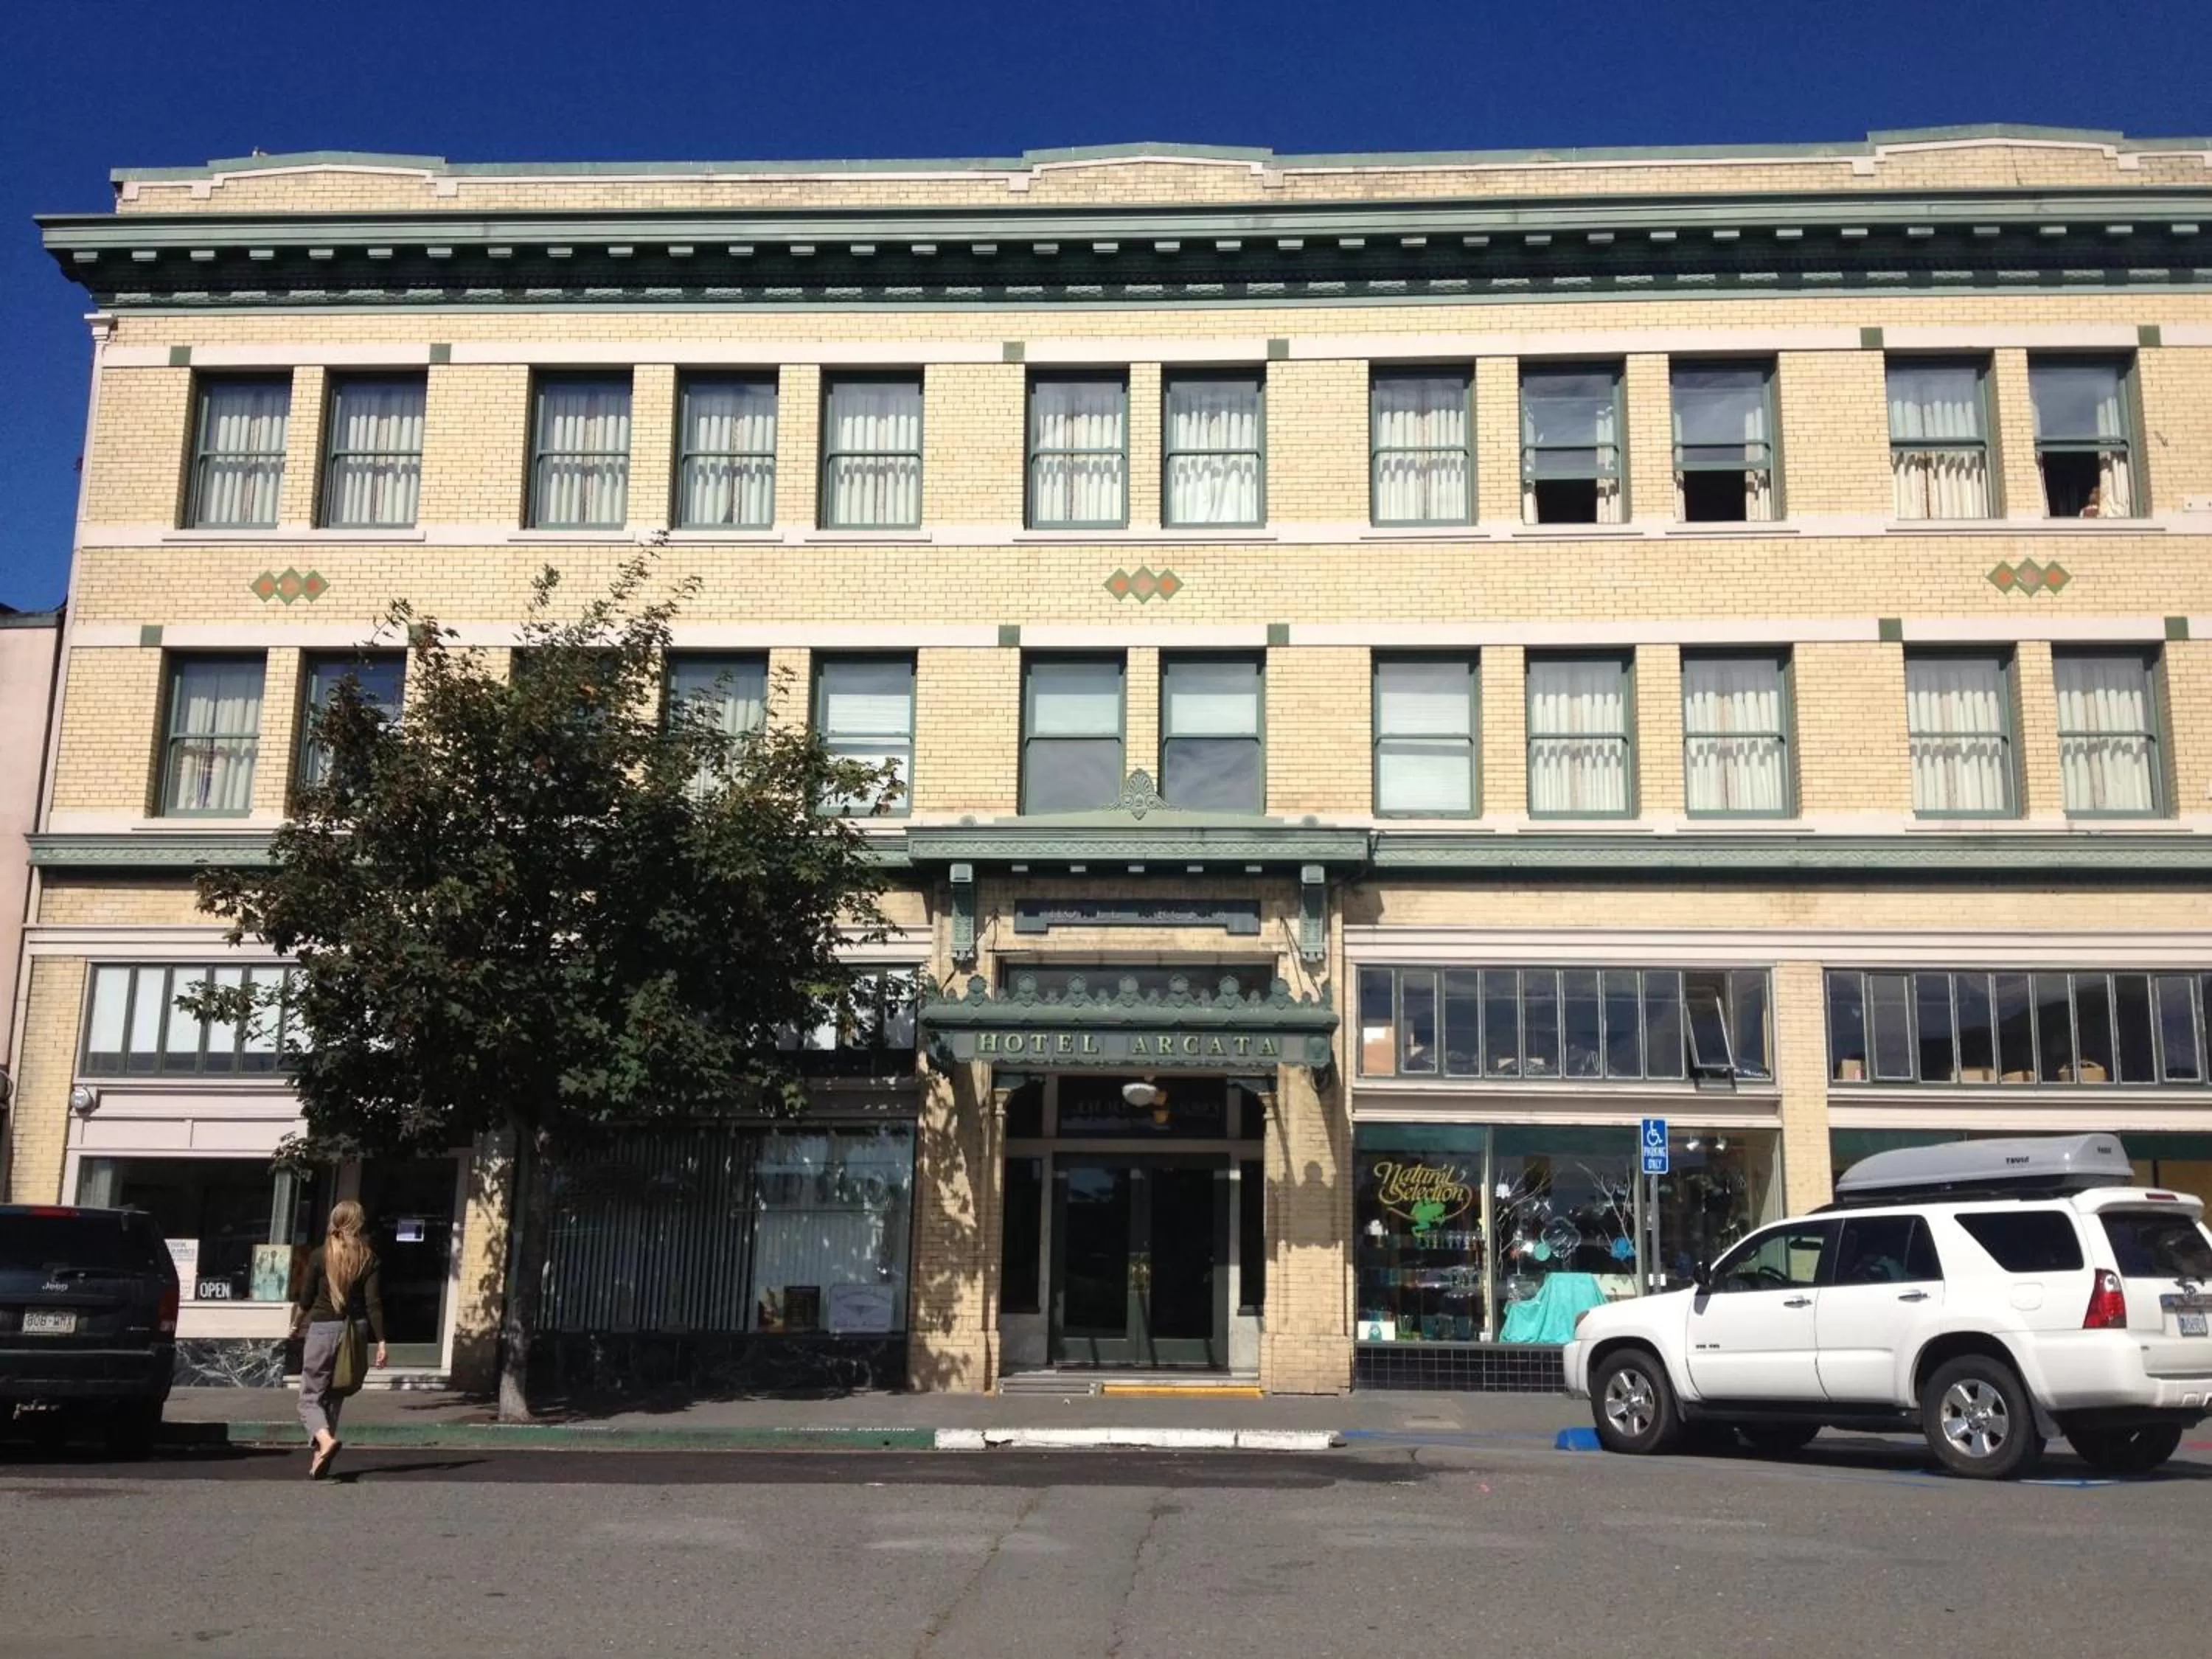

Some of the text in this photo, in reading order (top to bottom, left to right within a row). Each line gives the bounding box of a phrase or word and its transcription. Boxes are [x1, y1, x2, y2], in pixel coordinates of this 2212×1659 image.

[978, 1033, 1278, 1056] HOTEL ARCATA
[1648, 1158, 1662, 1169] ONLY
[1374, 1161, 1457, 1194] Natural
[1380, 1181, 1464, 1204] Selection
[42, 1281, 69, 1292] Jeep
[200, 1281, 230, 1298] OPEN
